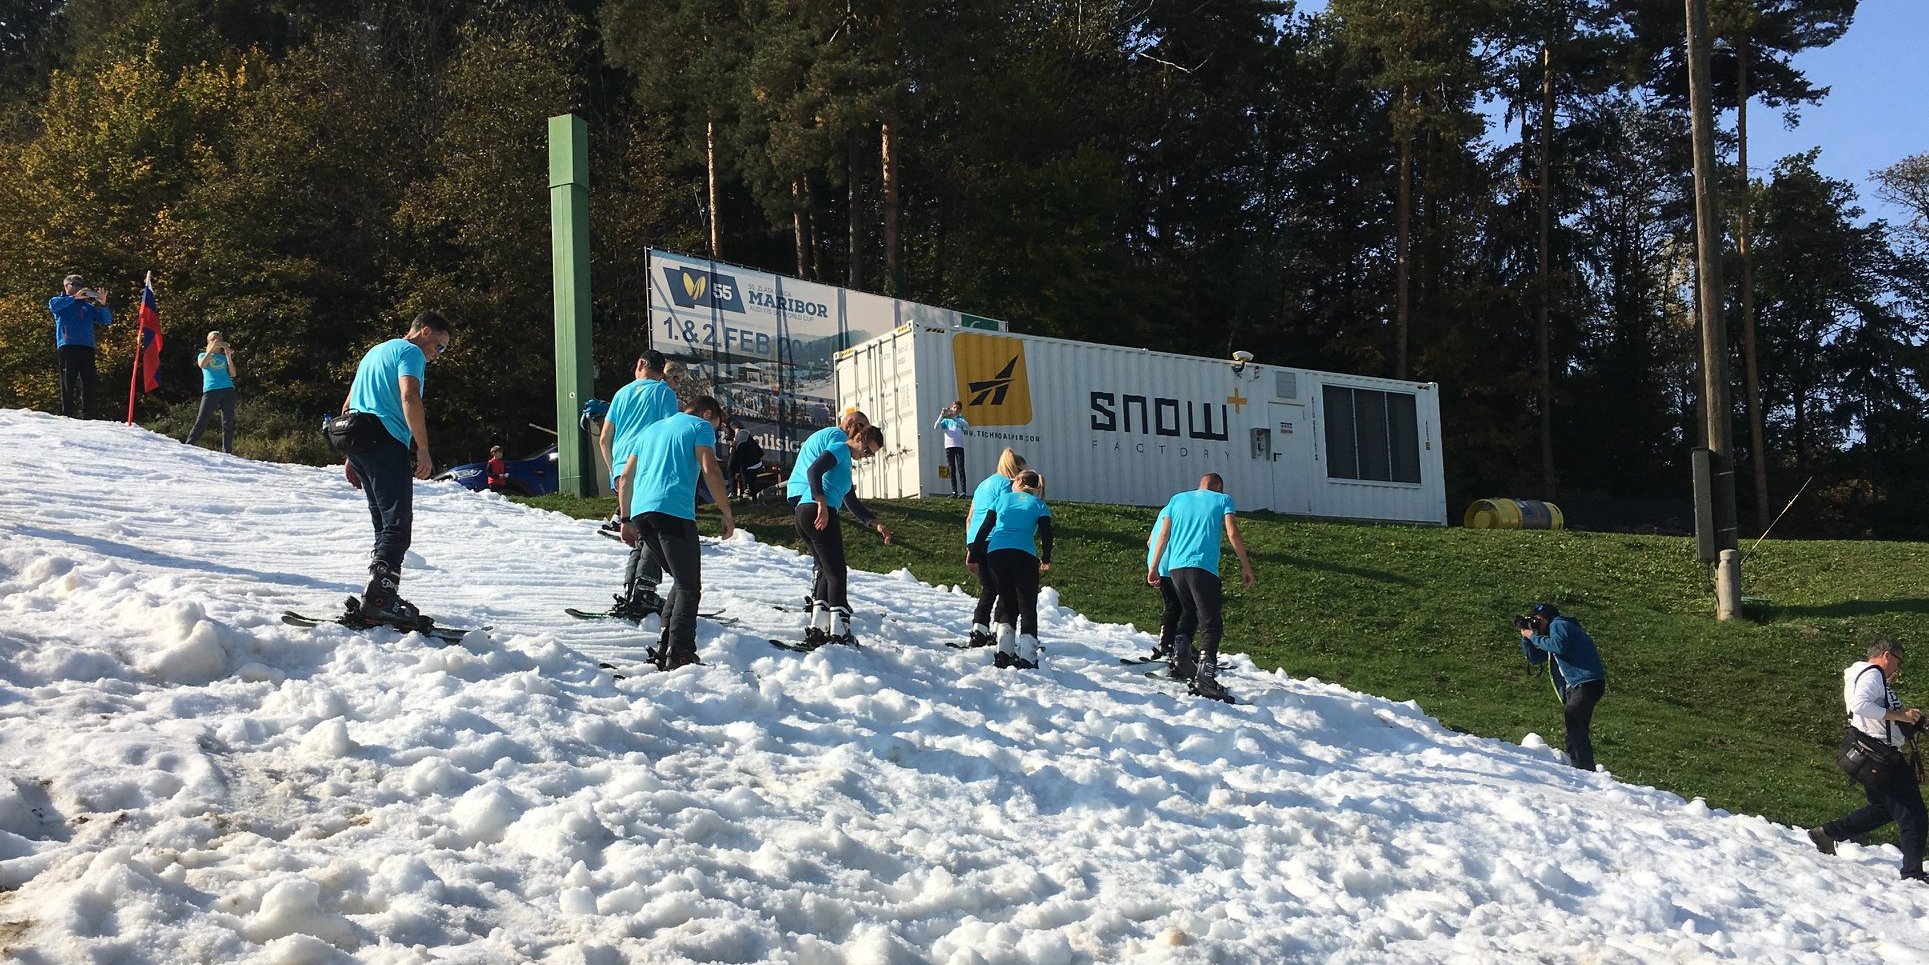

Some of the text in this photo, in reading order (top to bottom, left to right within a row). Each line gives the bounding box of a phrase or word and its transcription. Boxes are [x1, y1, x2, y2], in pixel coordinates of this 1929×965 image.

[713, 283, 732, 300] 55
[748, 290, 828, 318] MARIBOR
[1091, 440, 1231, 460] FACTORY
